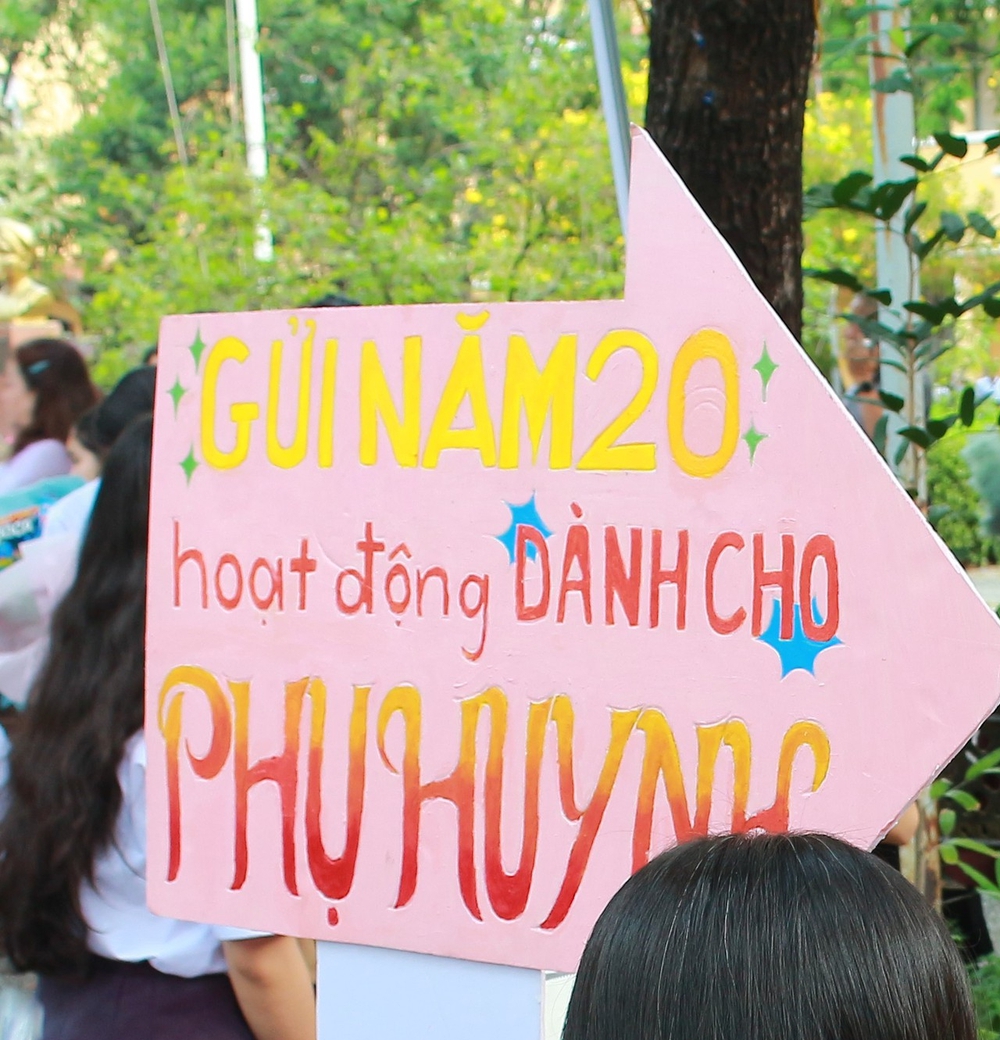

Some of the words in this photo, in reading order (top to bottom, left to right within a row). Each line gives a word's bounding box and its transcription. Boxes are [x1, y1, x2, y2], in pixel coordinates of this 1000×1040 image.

[199, 316, 338, 469] GỬI
[359, 309, 580, 472] NĂM
[576, 328, 741, 479] 20
[171, 520, 317, 626] hoạt
[335, 521, 490, 661] động
[515, 502, 689, 631] DÀNH
[704, 531, 840, 642] CHO
[157, 664, 371, 927] PHỤ
